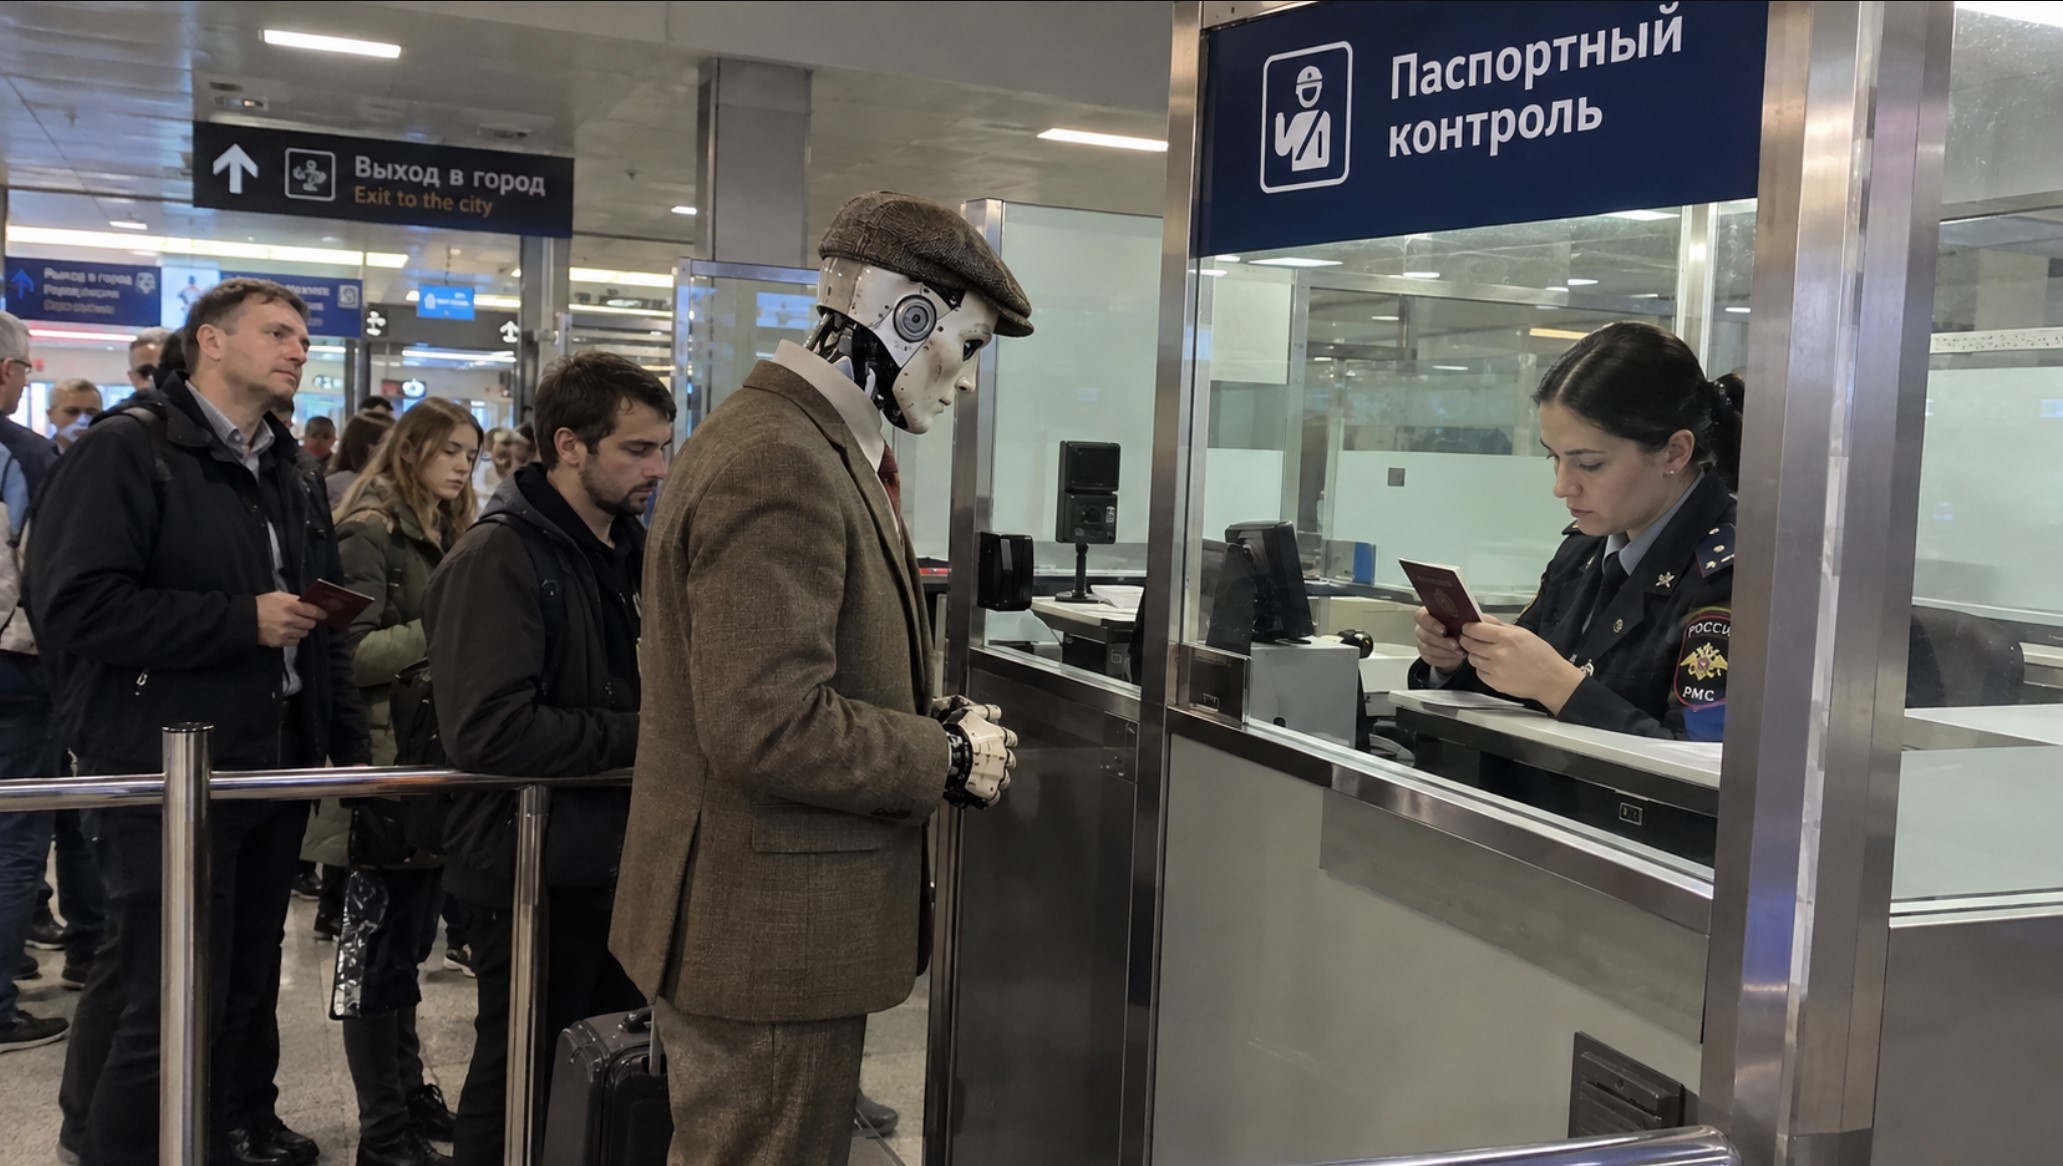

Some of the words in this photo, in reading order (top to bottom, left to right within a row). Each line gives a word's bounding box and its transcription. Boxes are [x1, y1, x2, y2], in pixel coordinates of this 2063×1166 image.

[1391, 2, 1683, 99] Паспортный
[1389, 97, 1602, 156] контроль
[355, 155, 440, 188] Выход
[449, 169, 464, 186] в
[473, 171, 546, 197] город
[354, 186, 391, 205] Exit
[397, 190, 417, 208] to
[423, 192, 454, 211] the
[459, 195, 494, 218] city
[1688, 622, 1731, 638] РОССИ
[1682, 685, 1715, 701] РМС
